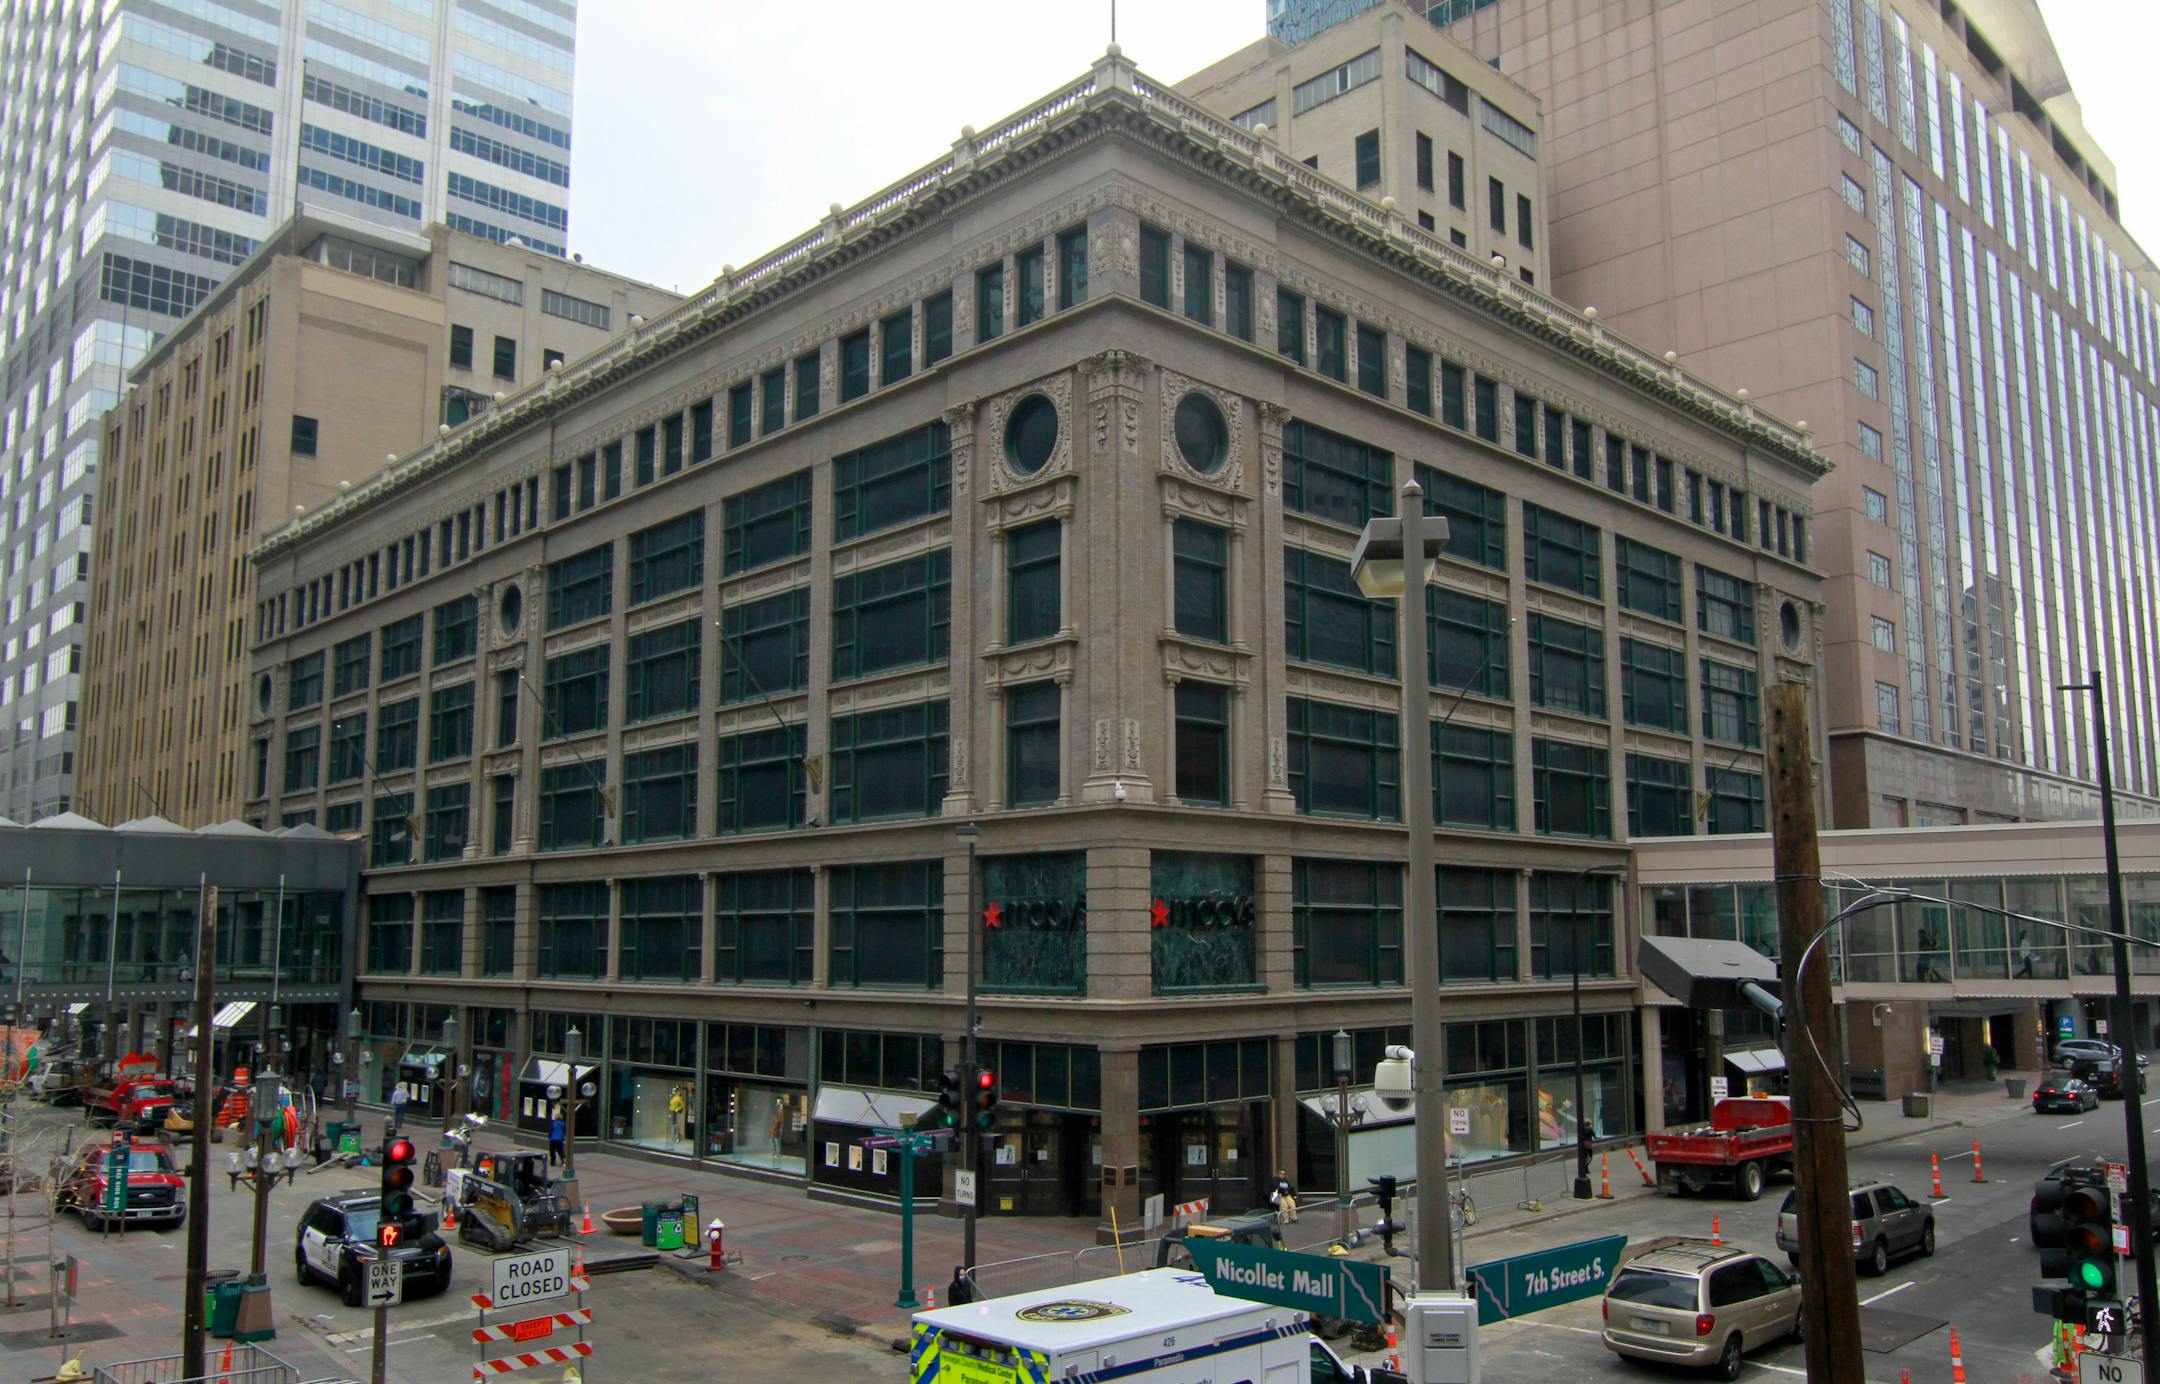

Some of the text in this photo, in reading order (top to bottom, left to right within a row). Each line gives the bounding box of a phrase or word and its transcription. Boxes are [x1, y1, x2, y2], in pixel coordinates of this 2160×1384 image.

[1453, 1109, 1465, 1118] NO
[960, 1177, 970, 1187] NO
[956, 1190, 974, 1200] TURNS
[372, 1263, 397, 1277] ONE
[509, 1258, 554, 1279] ROAD
[1216, 1256, 1334, 1298] Nicollet Mall
[1524, 1256, 1605, 1298] 7th Street S.
[371, 1276, 397, 1289] WAY
[500, 1276, 563, 1300] CLOSED
[1163, 1336, 1176, 1347] 426
[1153, 1350, 1185, 1367] Paramedic
[976, 1361, 996, 1375] Medical
[997, 1367, 1013, 1379] Center
[2099, 1364, 2122, 1383] NO
